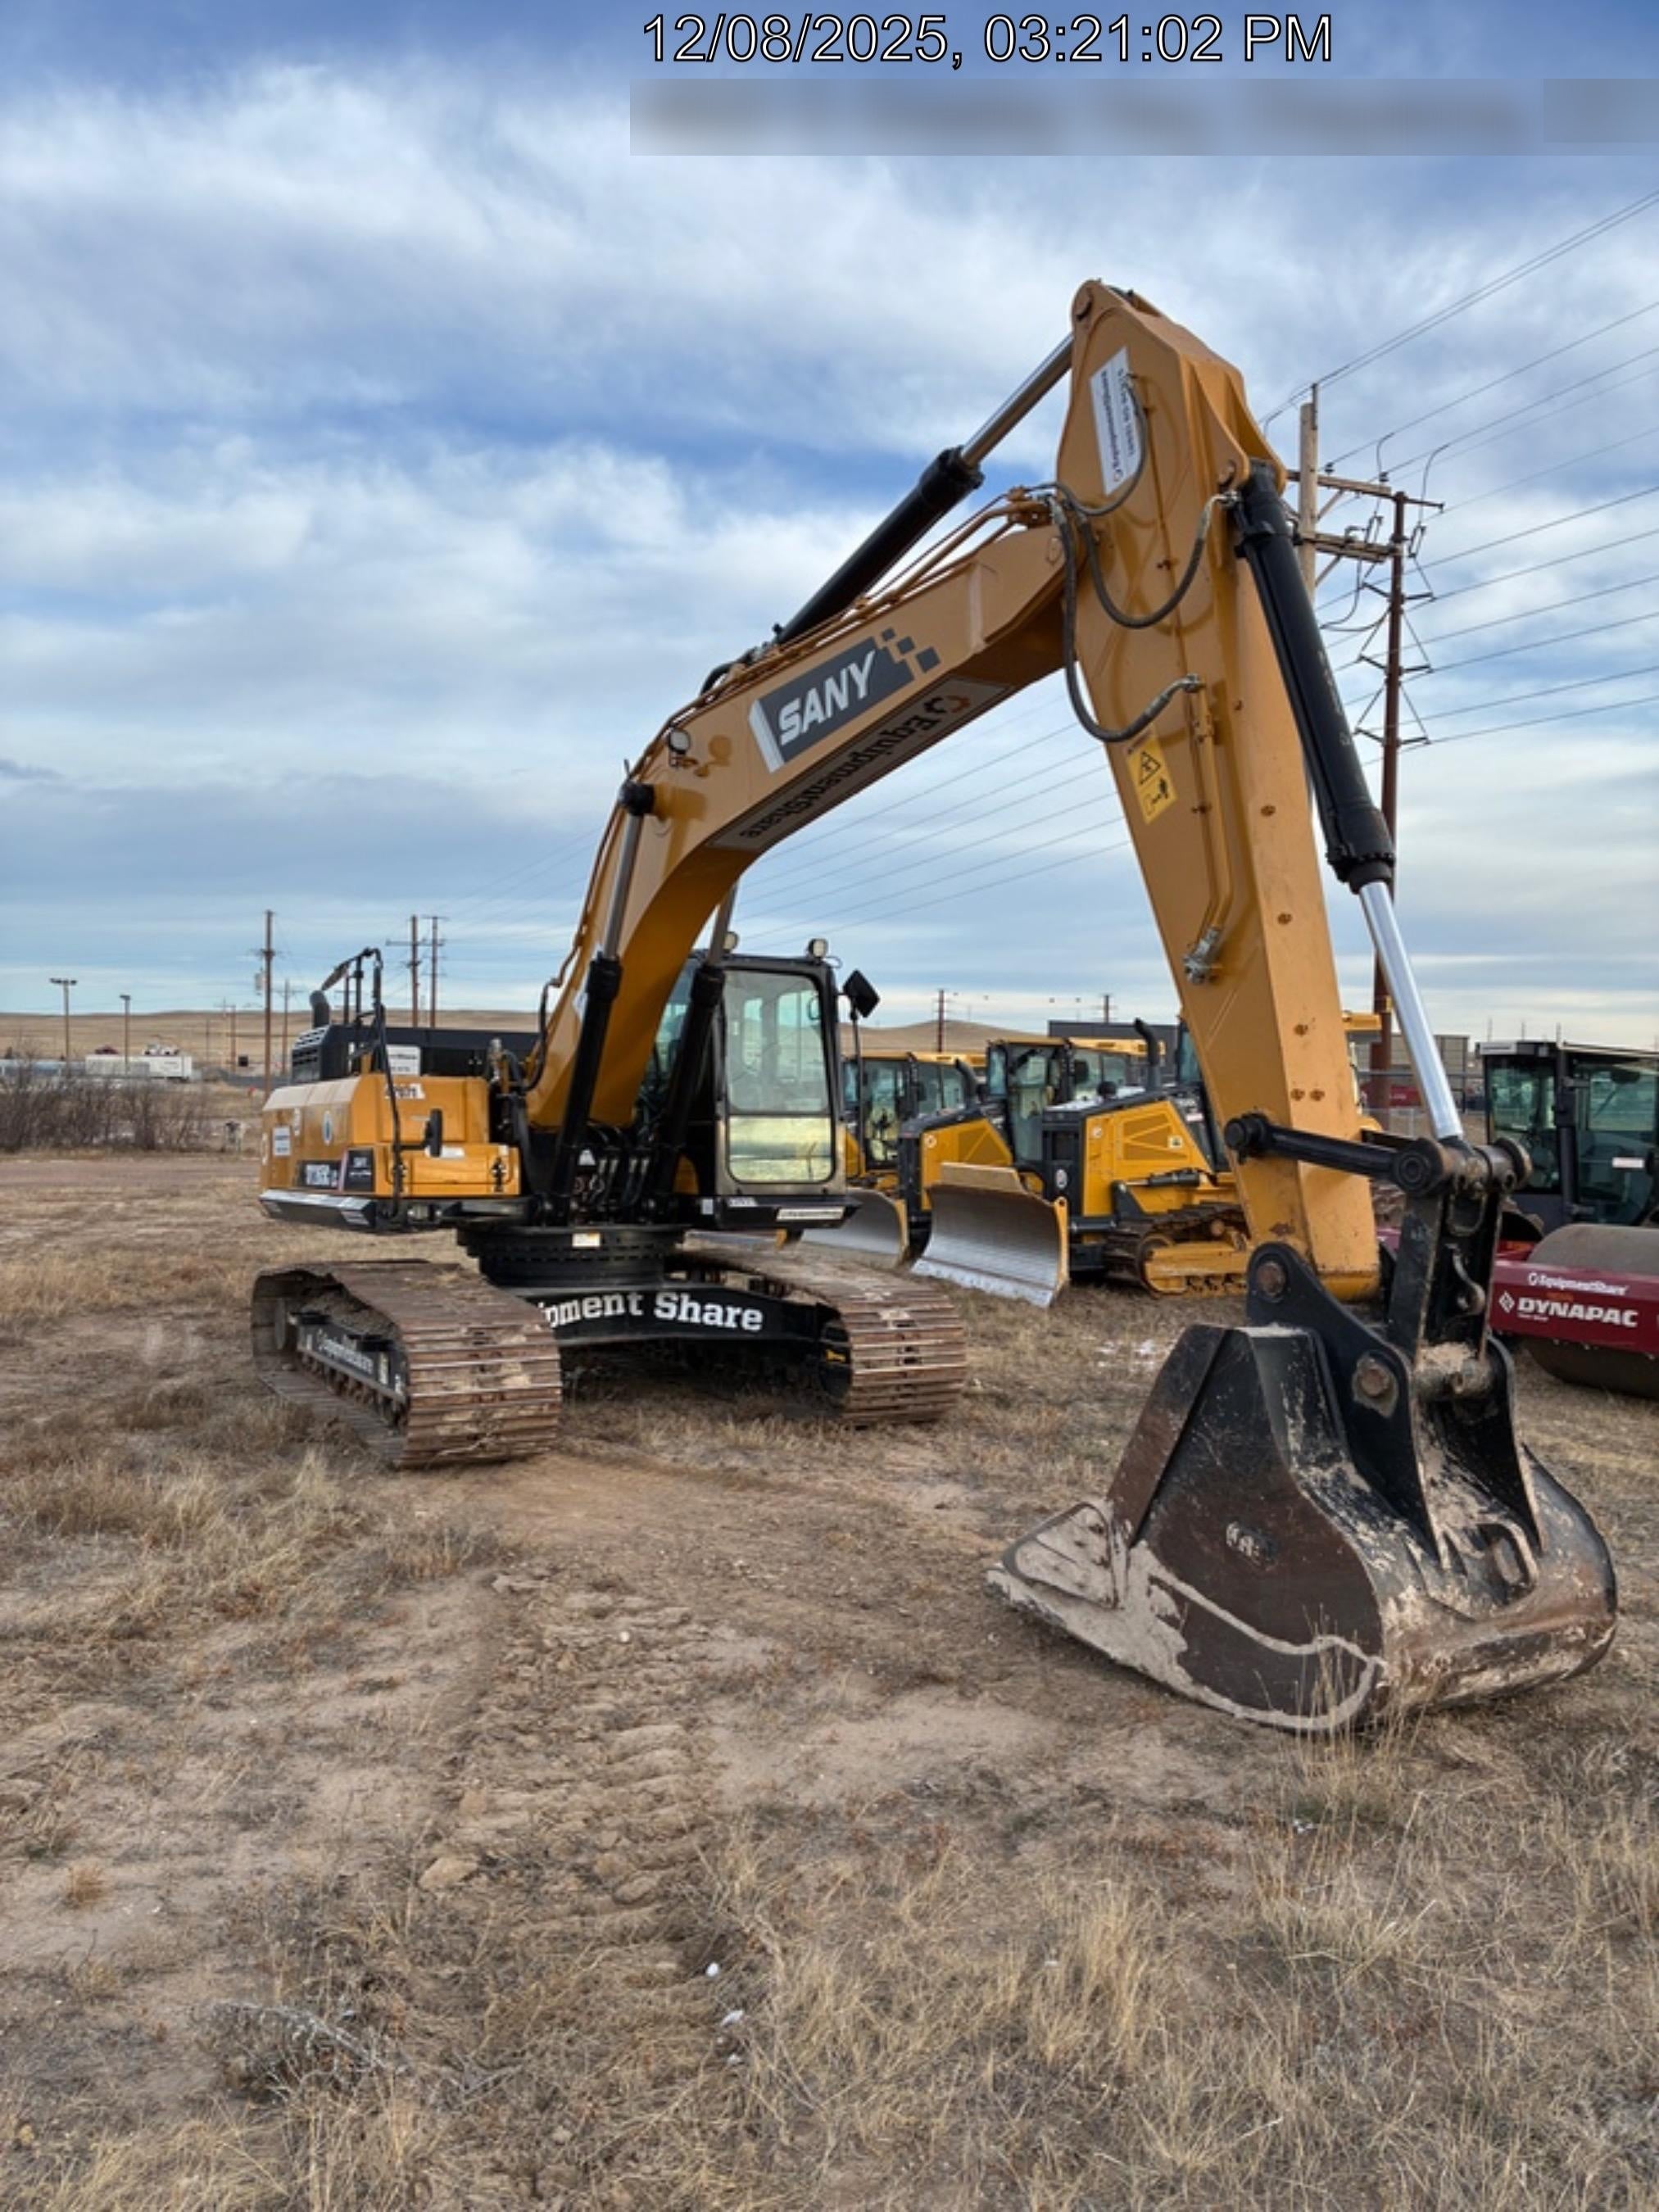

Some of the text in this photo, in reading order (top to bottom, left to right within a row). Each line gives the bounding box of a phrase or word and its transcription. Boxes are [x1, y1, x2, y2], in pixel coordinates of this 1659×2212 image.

[778, 650, 876, 746] SANY
[538, 1292, 764, 1331] pment Share
[1517, 1297, 1639, 1328] DYNAPAC
